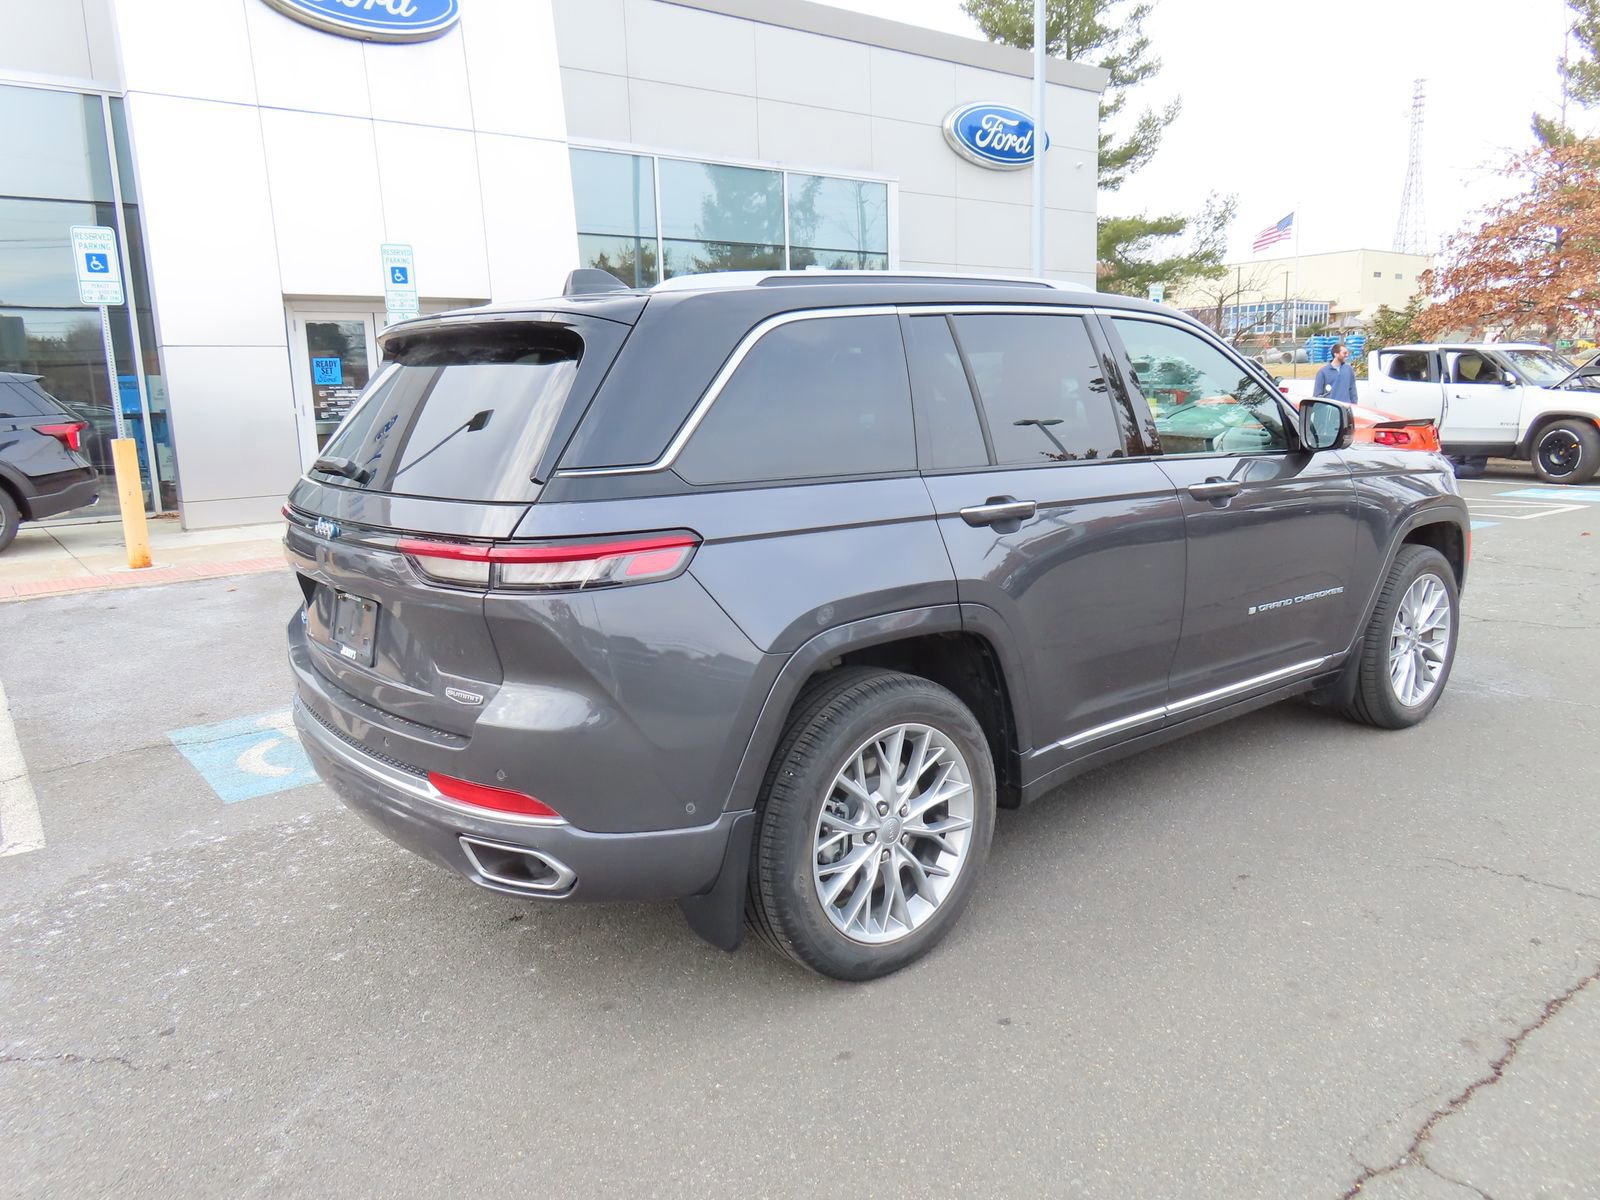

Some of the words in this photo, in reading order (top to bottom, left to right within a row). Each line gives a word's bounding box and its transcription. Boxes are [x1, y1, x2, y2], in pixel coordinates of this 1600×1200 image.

[975, 114, 1033, 154] Ford
[74, 231, 112, 241] RESERVED
[78, 242, 112, 251] PARKING
[315, 360, 337, 368] READY
[320, 367, 333, 375] SET
[1258, 598, 1293, 612] GRAND
[1294, 586, 1345, 604] CHEROKEE
[447, 689, 480, 702] SUMMIT
